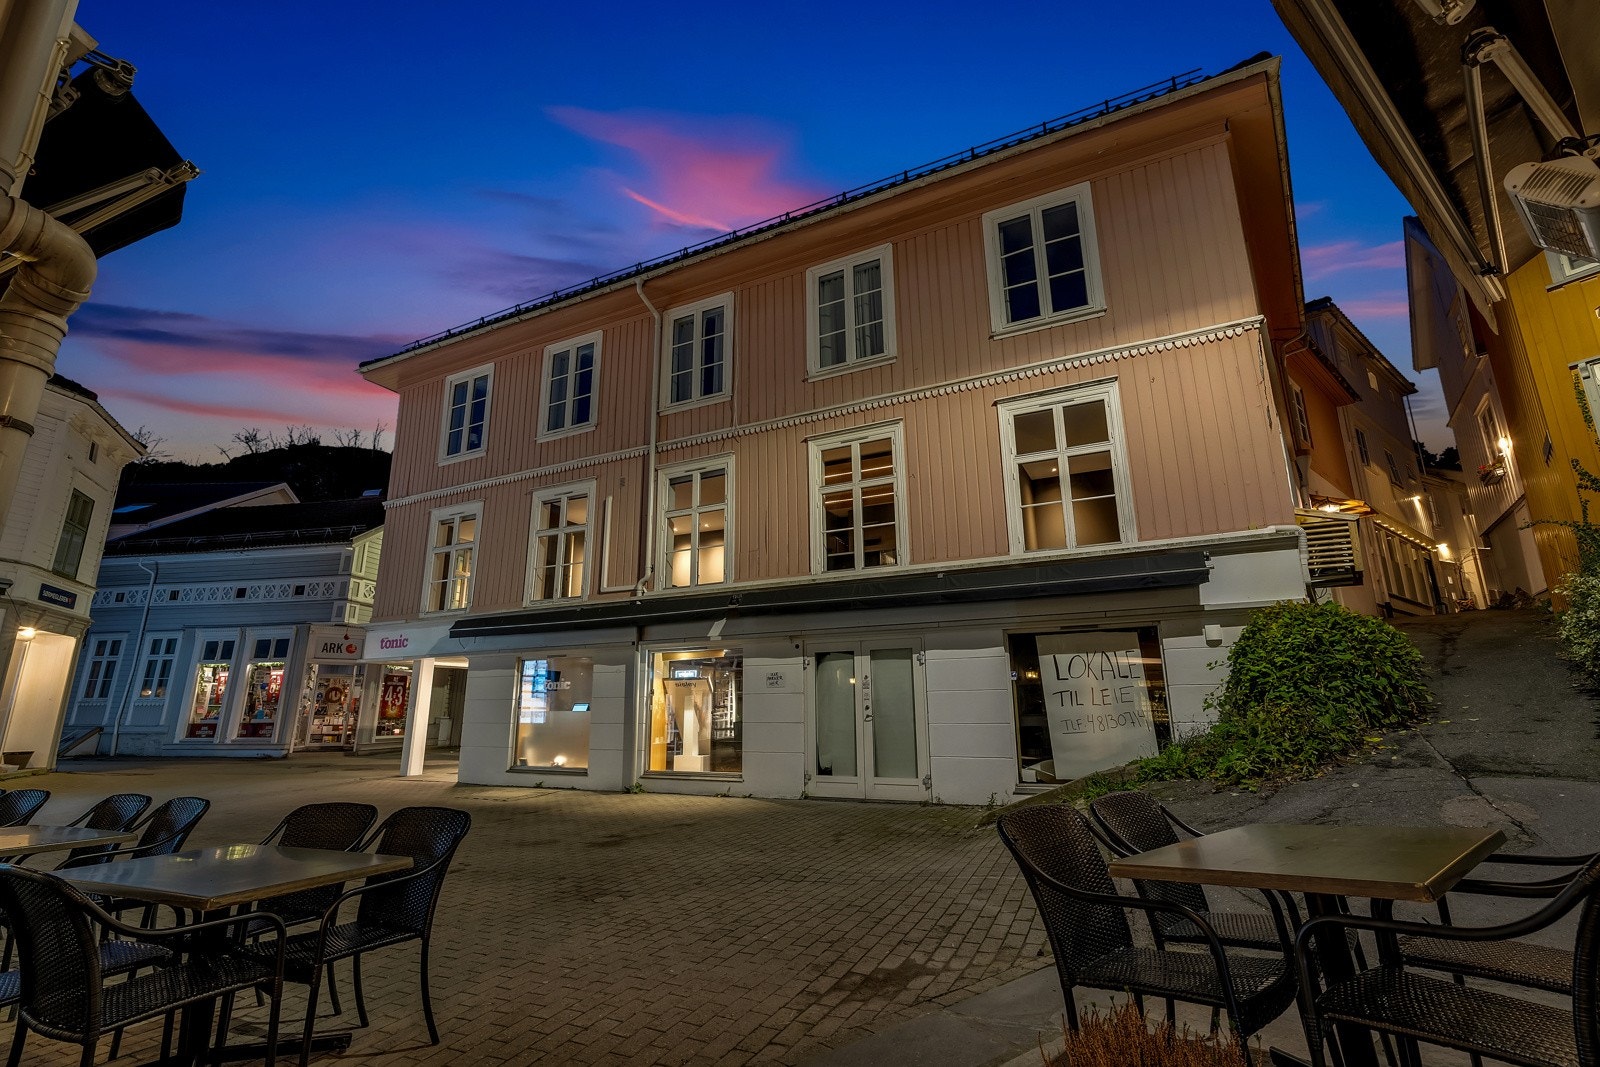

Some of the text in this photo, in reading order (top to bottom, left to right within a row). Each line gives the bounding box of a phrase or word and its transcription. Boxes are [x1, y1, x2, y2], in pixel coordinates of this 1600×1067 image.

[321, 642, 343, 654] ARK
[380, 634, 408, 650] tonic
[1052, 650, 1140, 681] LOKALE
[544, 678, 571, 691] tonic
[1052, 685, 1134, 707] TIL LEIE
